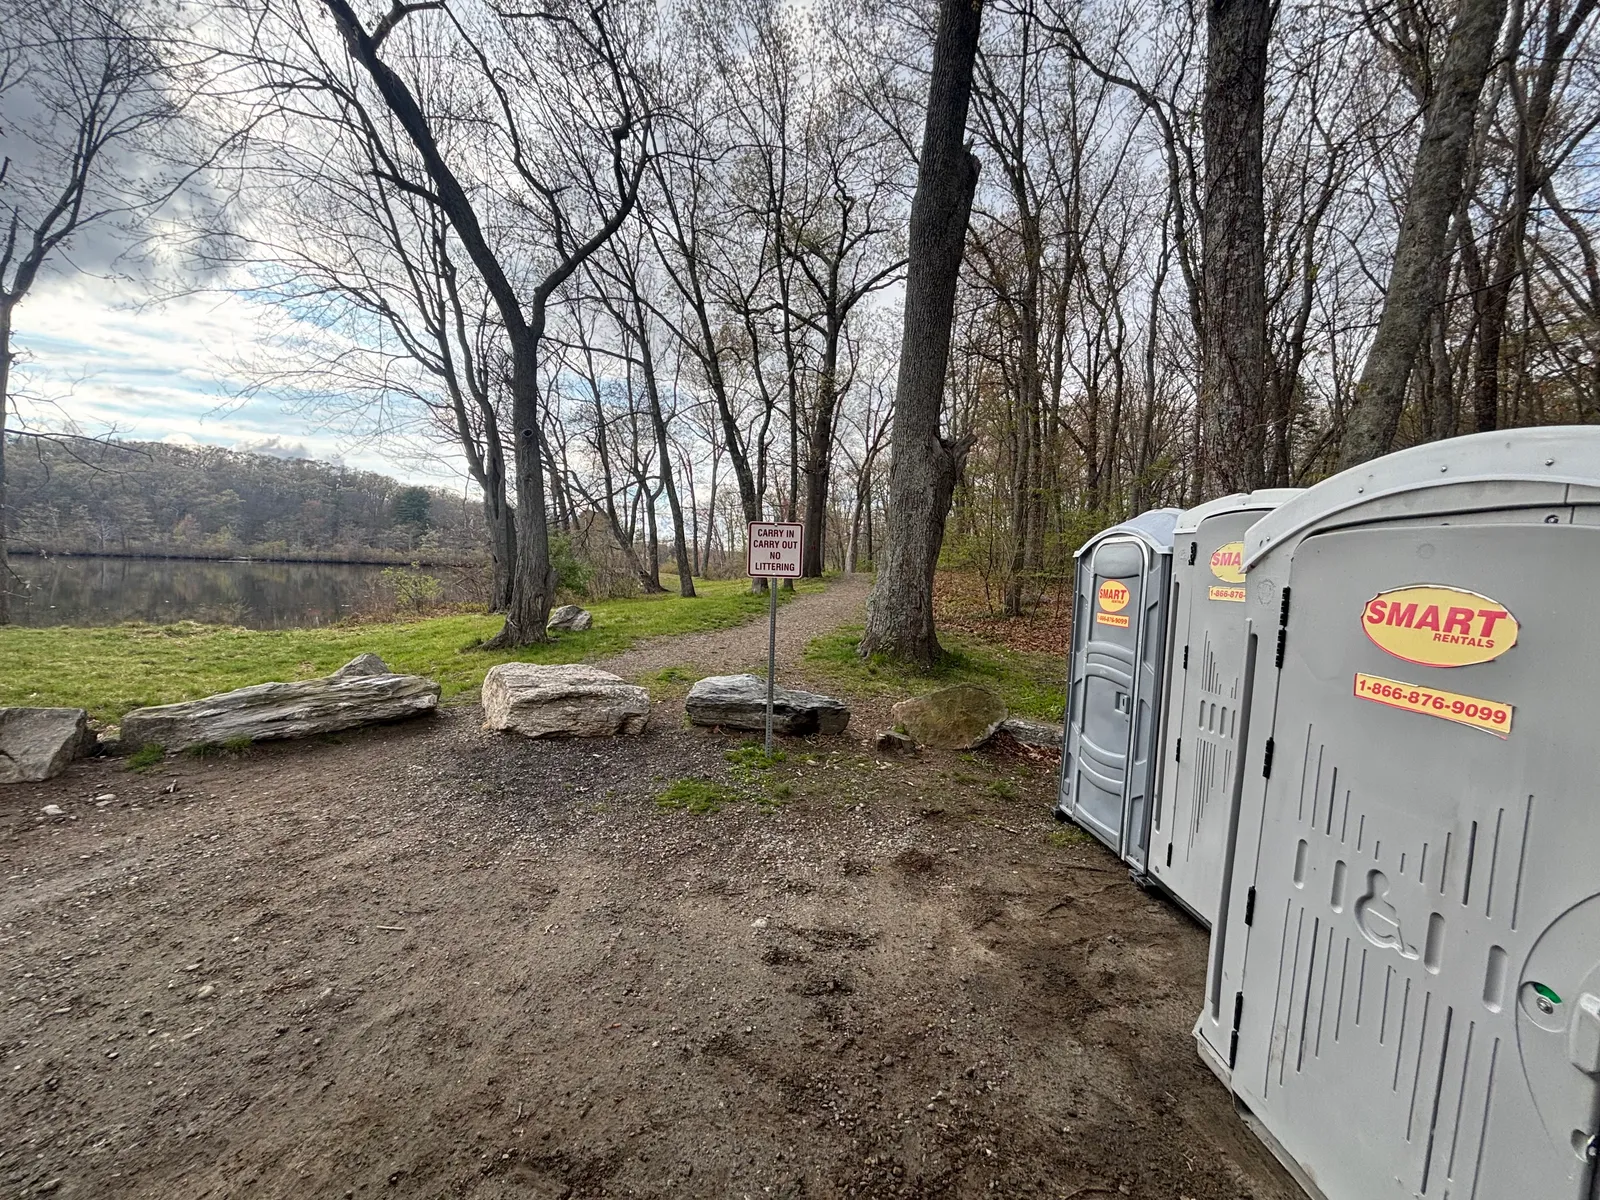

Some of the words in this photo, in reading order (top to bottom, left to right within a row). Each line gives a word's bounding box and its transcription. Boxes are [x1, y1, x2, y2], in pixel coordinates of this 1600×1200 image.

[757, 528, 784, 538] CARRY
[786, 529, 795, 538] IN
[753, 539, 780, 549] CARRY
[781, 540, 798, 549] OUT
[769, 551, 781, 560] NO
[1211, 551, 1242, 567] SMA
[755, 562, 795, 571] LITTERING
[1099, 588, 1127, 600] SMART
[1366, 599, 1508, 638] SMART
[1432, 632, 1496, 649] RENTALS
[1358, 679, 1508, 725] 1-866-876-9099
